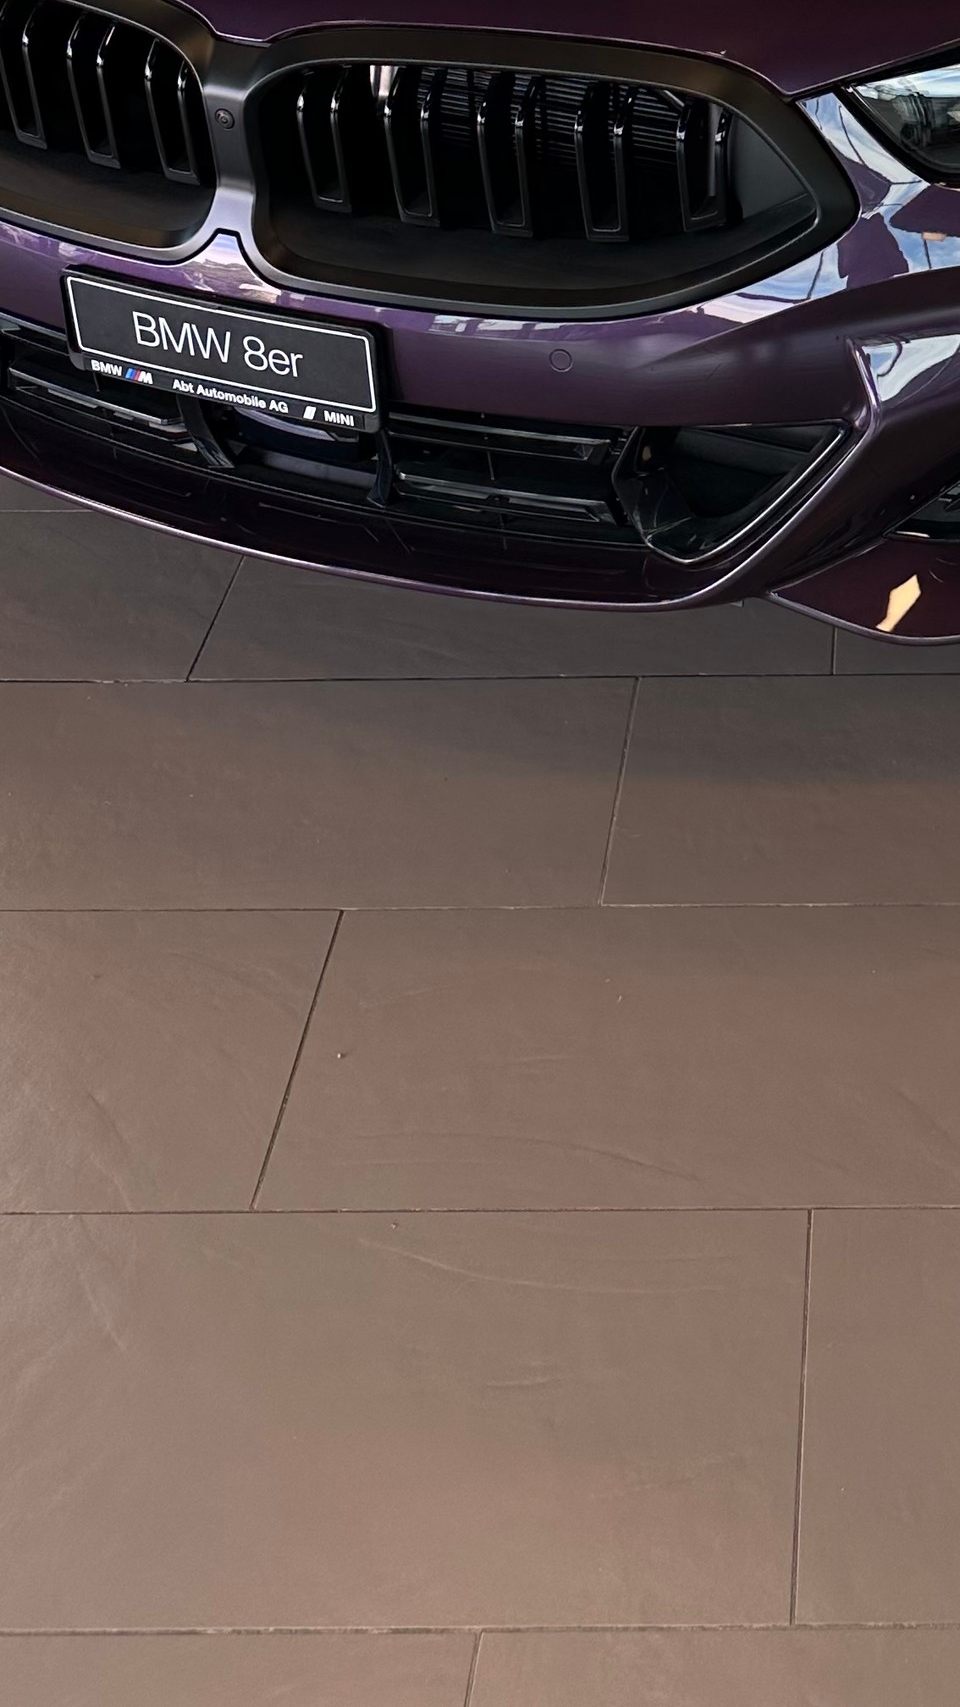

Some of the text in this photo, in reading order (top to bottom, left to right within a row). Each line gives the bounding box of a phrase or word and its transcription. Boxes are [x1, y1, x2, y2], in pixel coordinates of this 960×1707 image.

[131, 310, 304, 379] BMW 8er
[91, 359, 123, 378] BMW
[172, 378, 289, 414] Abt Automobile AG
[323, 410, 355, 427] MINI
